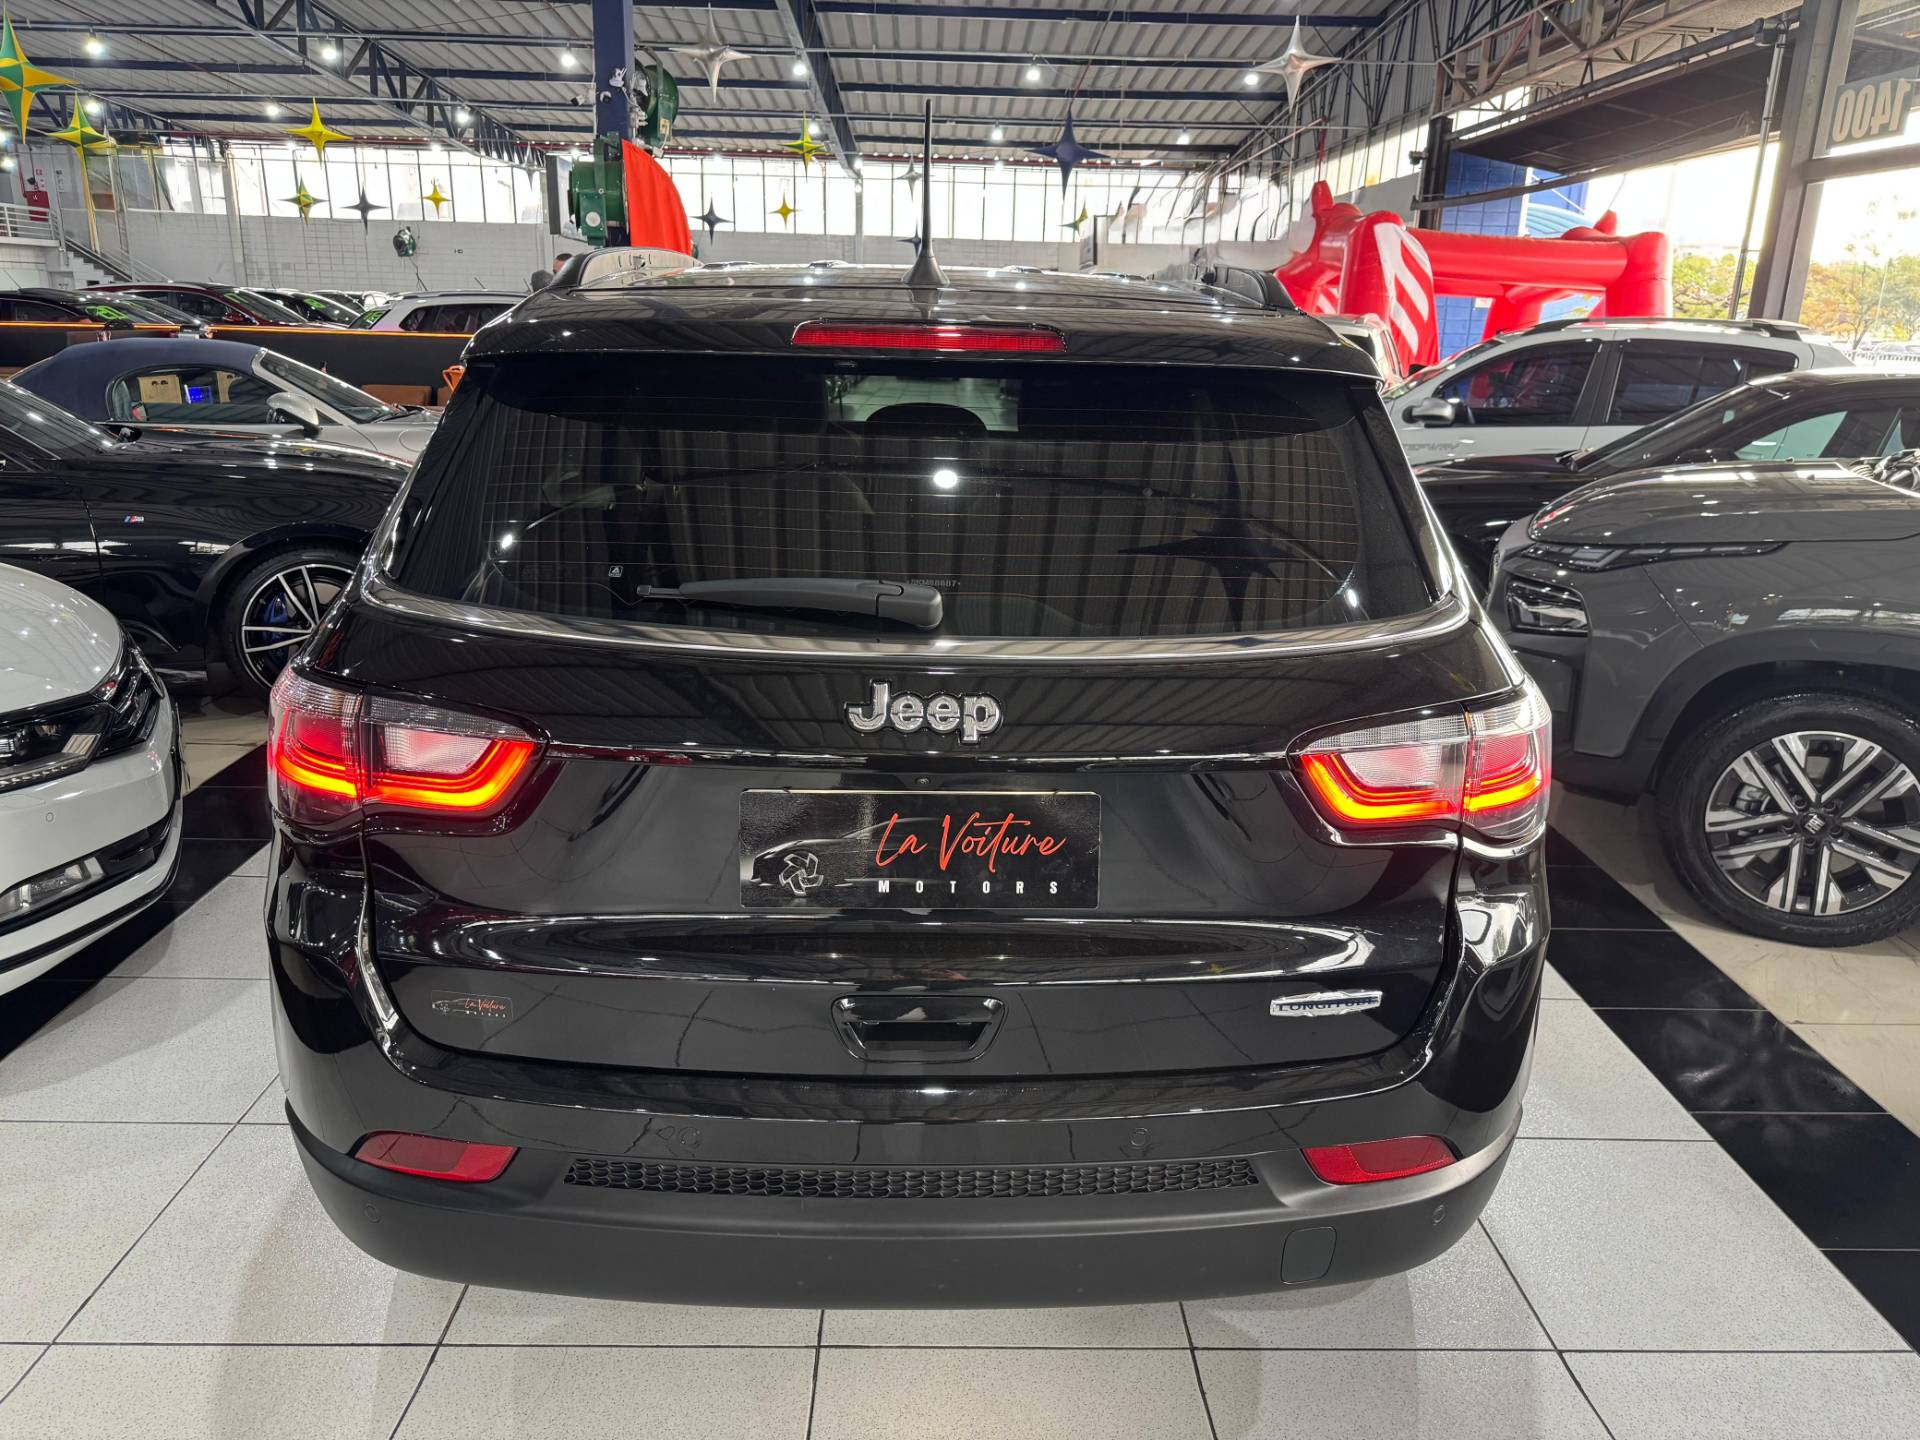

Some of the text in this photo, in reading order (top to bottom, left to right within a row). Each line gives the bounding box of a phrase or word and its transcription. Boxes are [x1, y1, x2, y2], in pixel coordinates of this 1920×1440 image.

[847, 681, 1001, 743] Jeep
[874, 811, 1067, 873] La Voiture
[878, 879, 1059, 895] MOTORS
